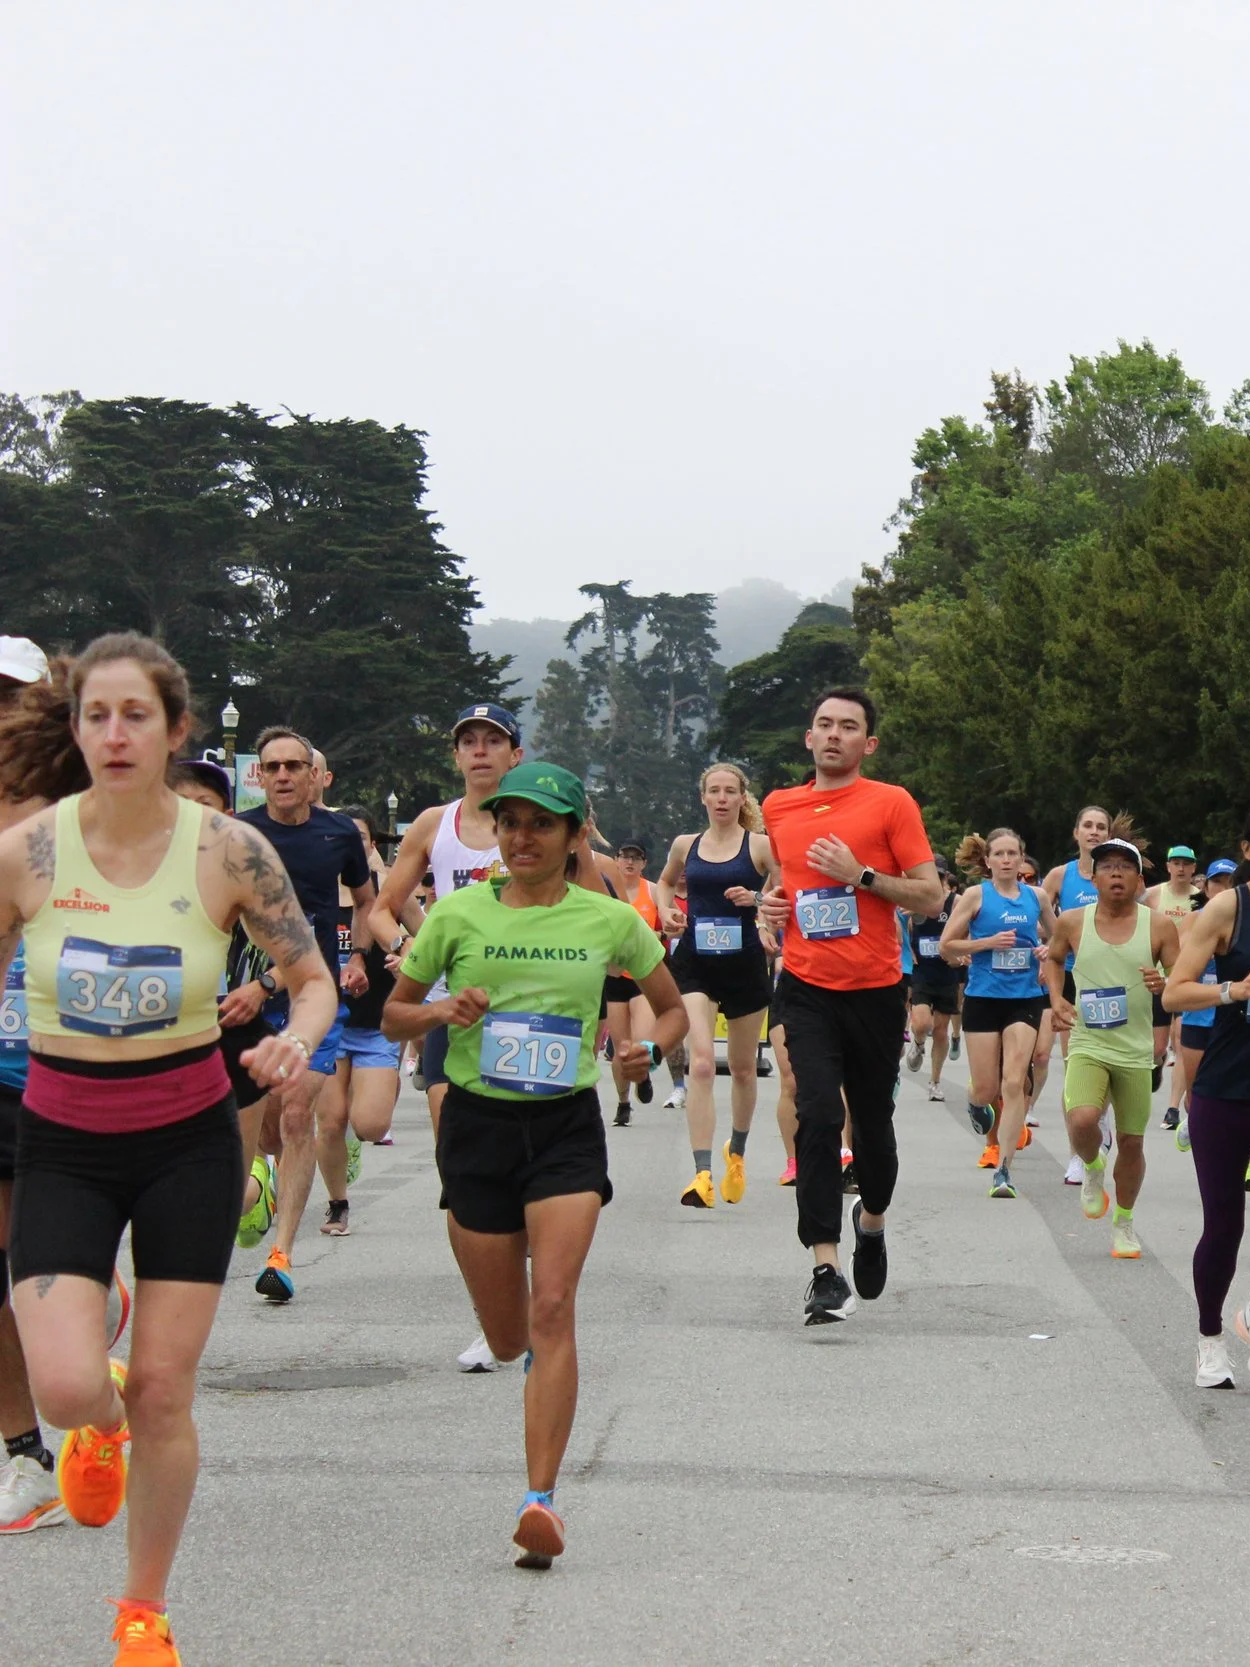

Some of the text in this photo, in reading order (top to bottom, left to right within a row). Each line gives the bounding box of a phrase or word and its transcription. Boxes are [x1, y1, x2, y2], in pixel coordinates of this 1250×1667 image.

[53, 899, 110, 913] EXCELSIOR
[802, 902, 852, 930] 322
[338, 930, 351, 940] ST
[707, 929, 731, 947] 84
[484, 946, 588, 961] PAMAKIDS
[998, 951, 1026, 966] 125
[68, 970, 168, 1019] 348
[0, 997, 28, 1033] 6
[1086, 1000, 1121, 1021] 318
[494, 1036, 567, 1079] 219
